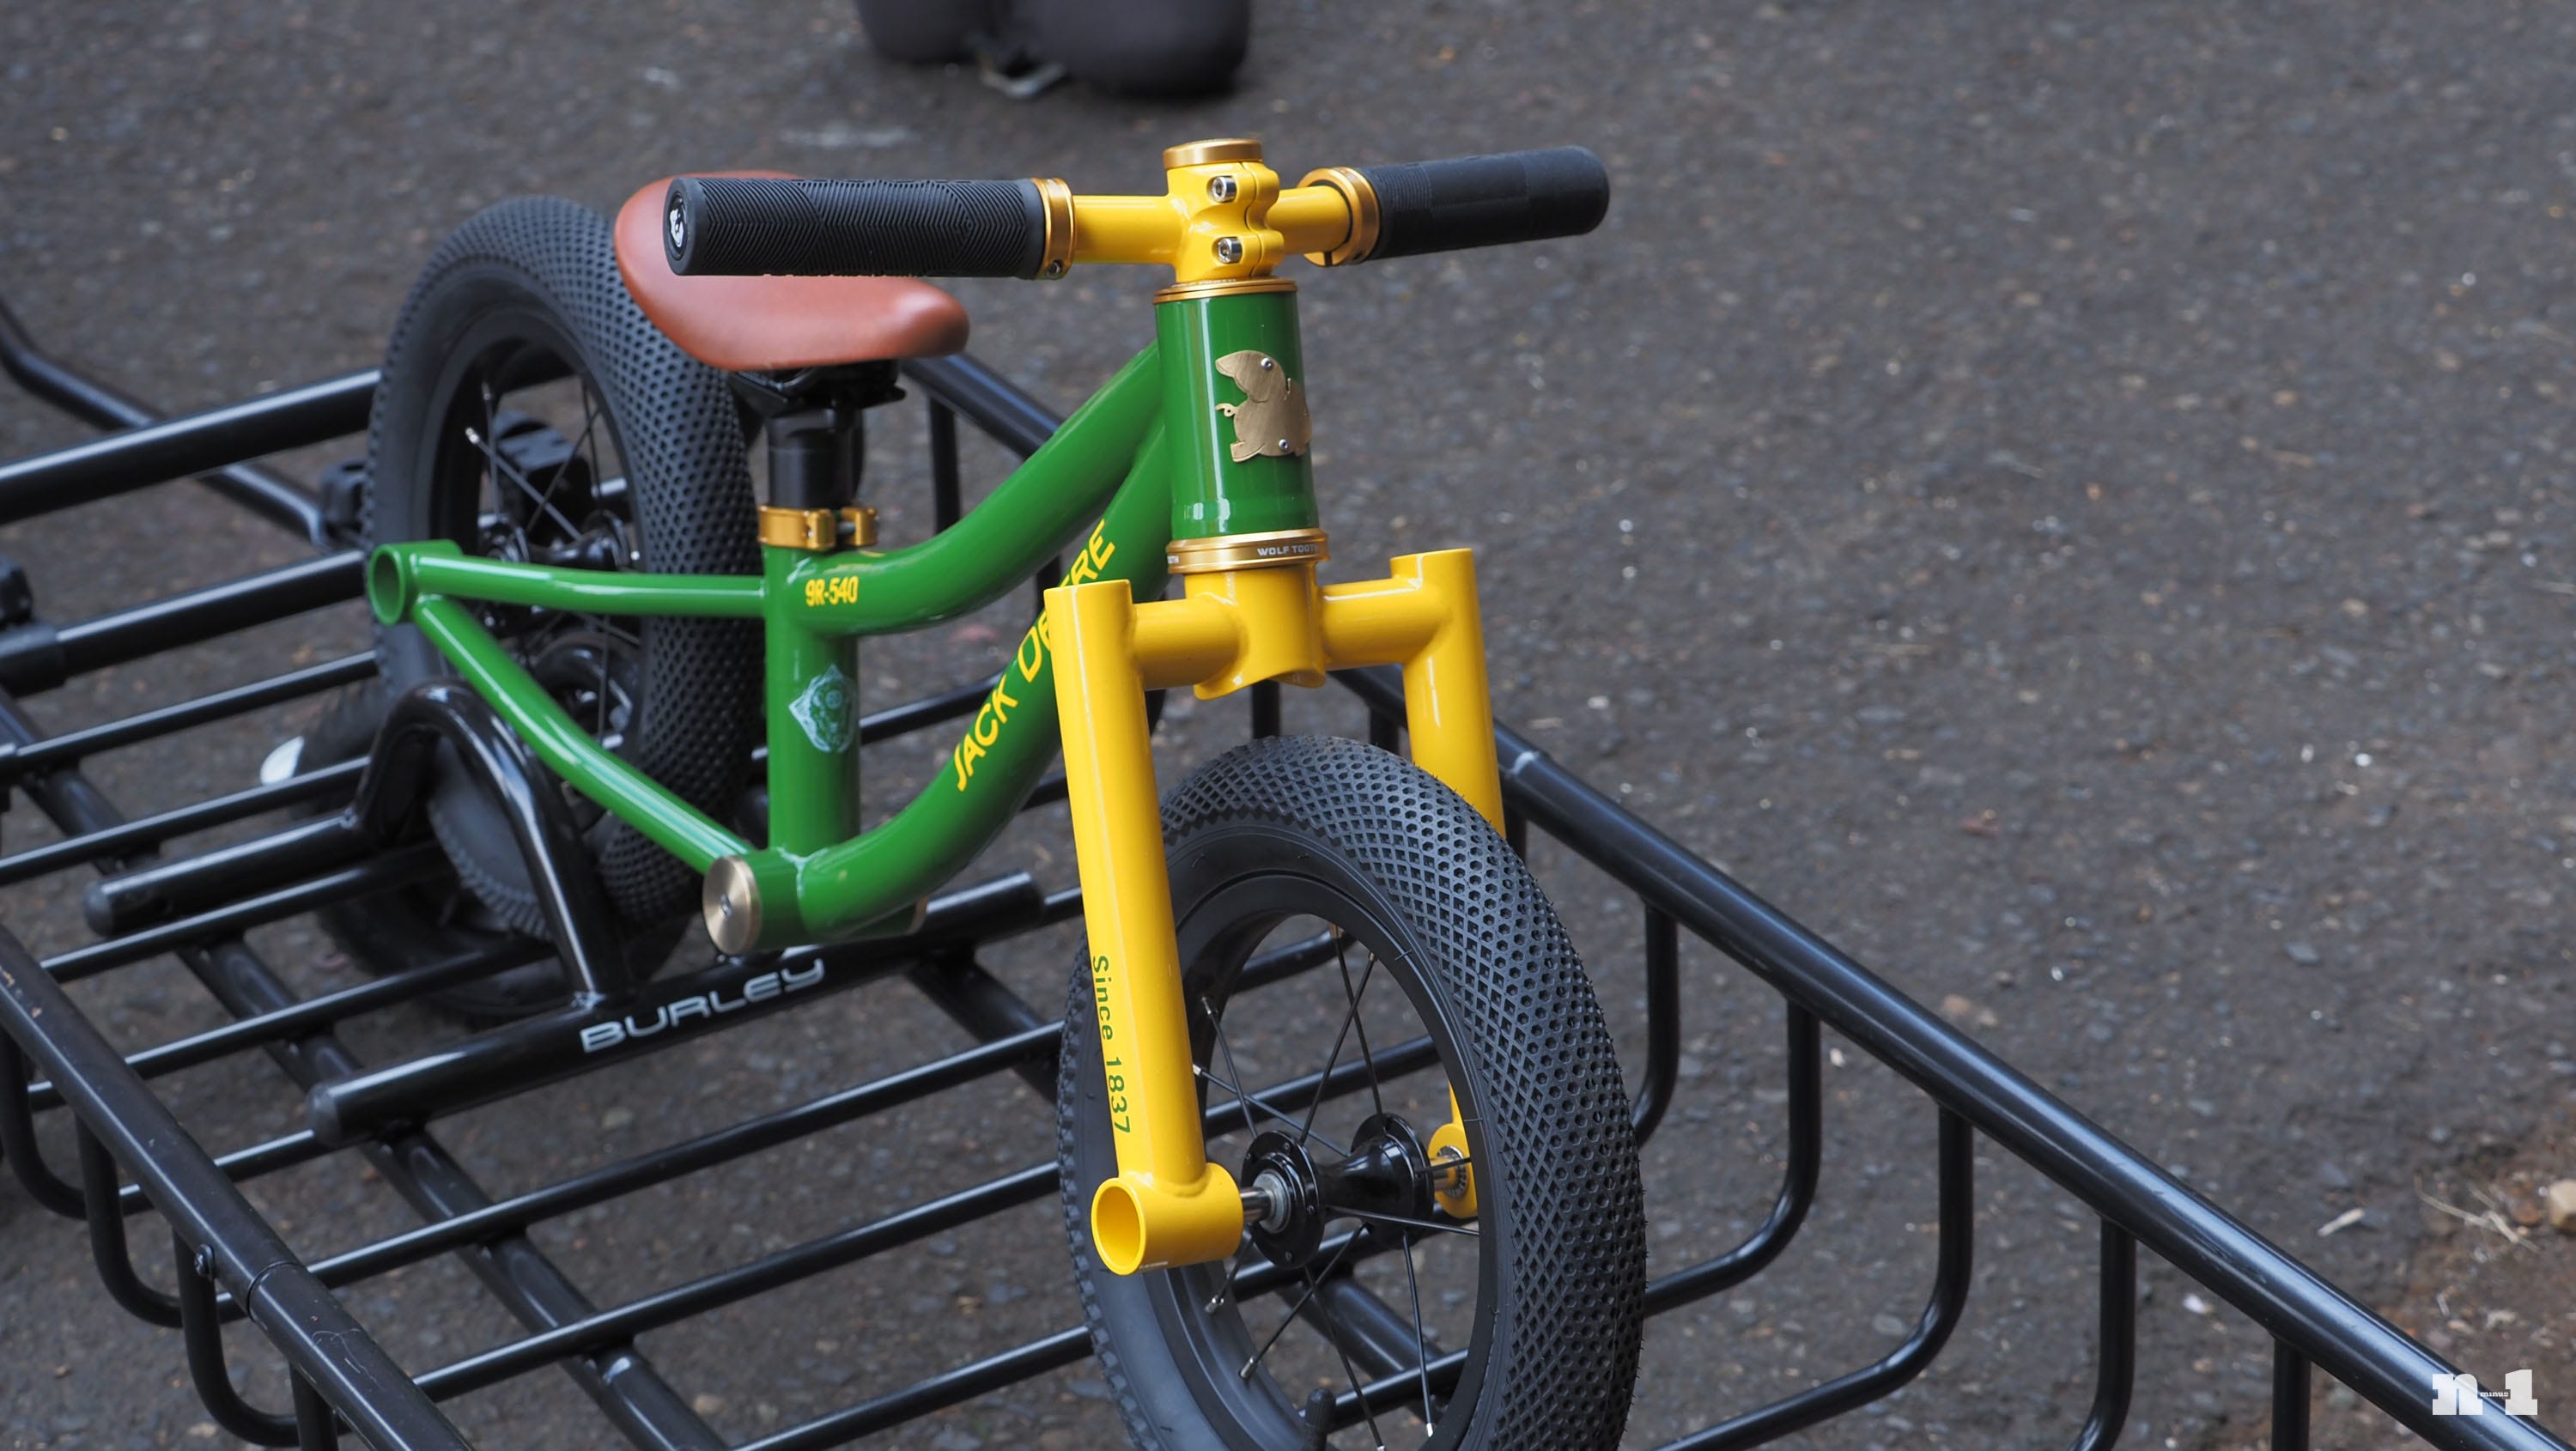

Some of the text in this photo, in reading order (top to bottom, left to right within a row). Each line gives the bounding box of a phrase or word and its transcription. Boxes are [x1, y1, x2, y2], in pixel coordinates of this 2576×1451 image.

[1257, 546, 1290, 556] WOLF
[954, 519, 1116, 792] JACK DERE
[579, 957, 825, 1053] BURLEY
[1093, 955, 1131, 1133] Since 1837
